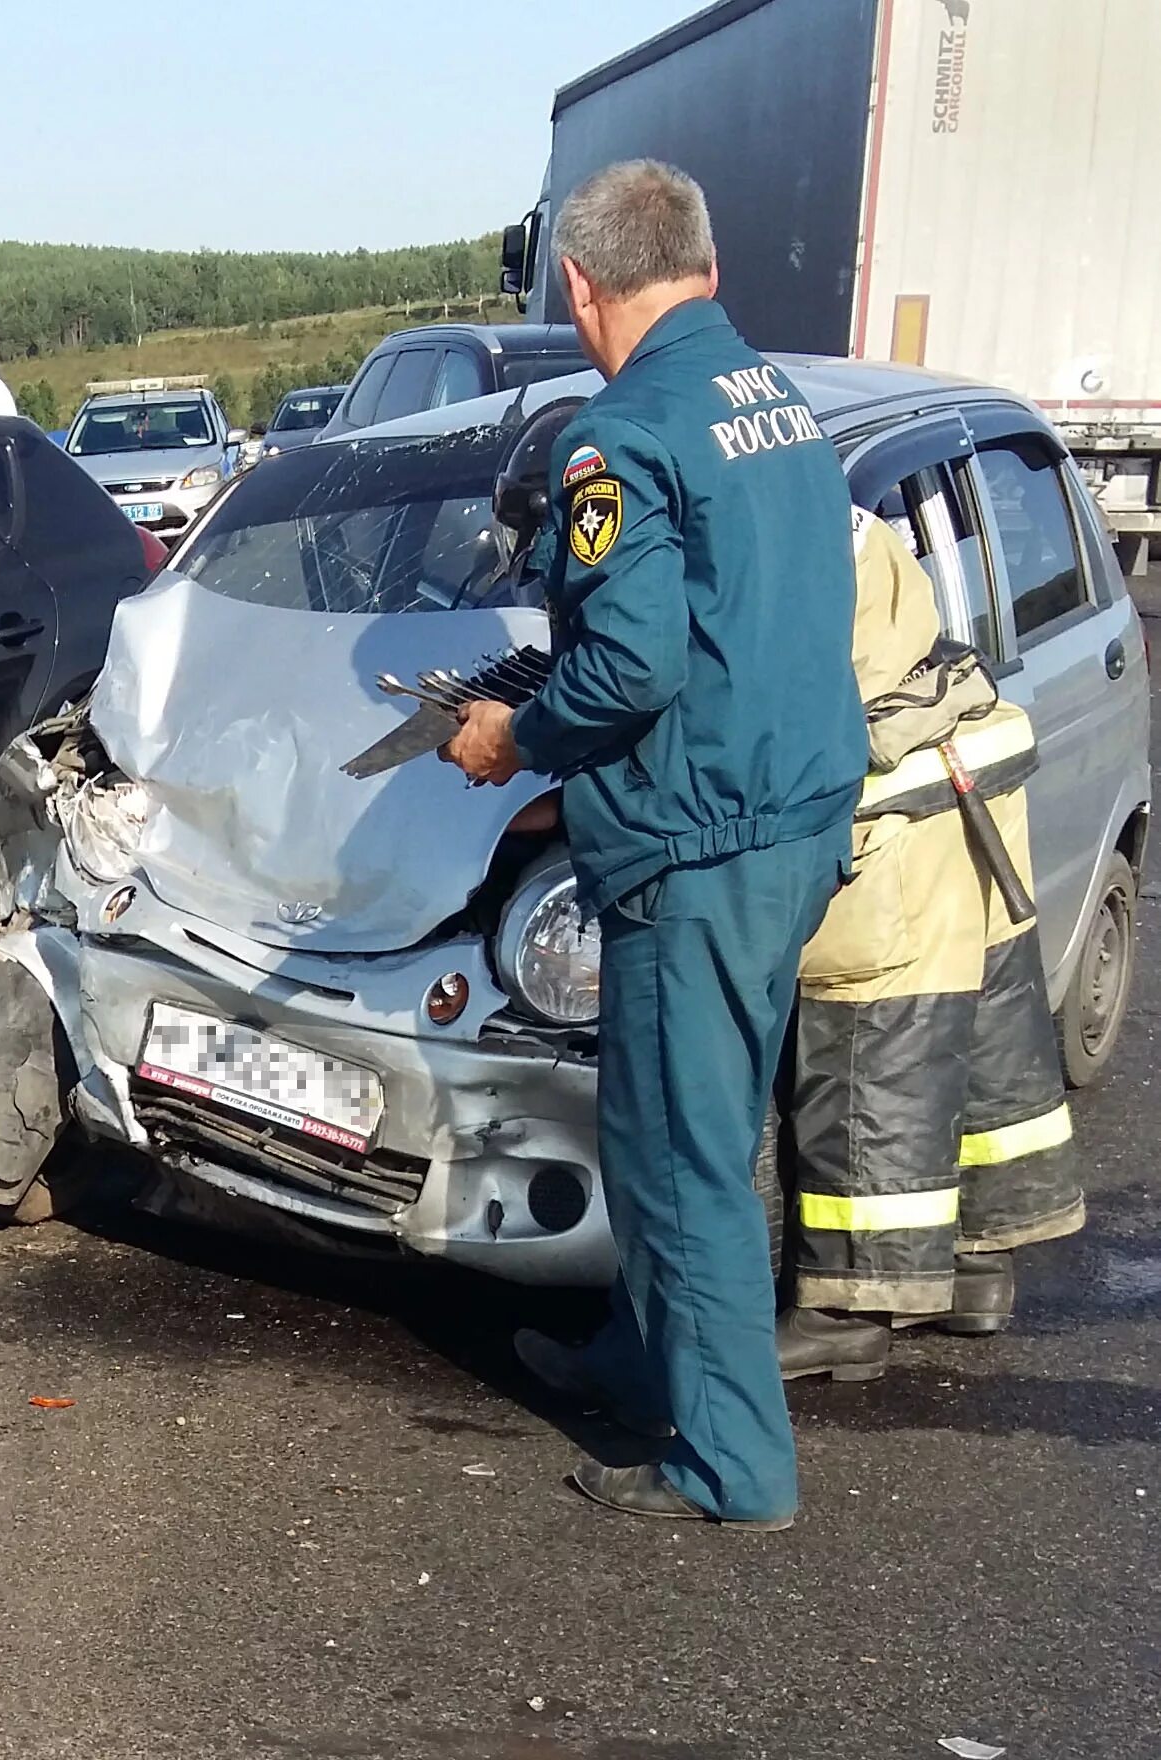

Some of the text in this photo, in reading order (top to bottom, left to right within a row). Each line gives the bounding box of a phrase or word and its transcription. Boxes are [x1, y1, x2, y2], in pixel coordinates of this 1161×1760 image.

[932, 29, 954, 133] SCHMITZ
[947, 29, 966, 133] CARGOBULL
[711, 364, 789, 409] МЧС
[569, 464, 597, 482] RUSSIA
